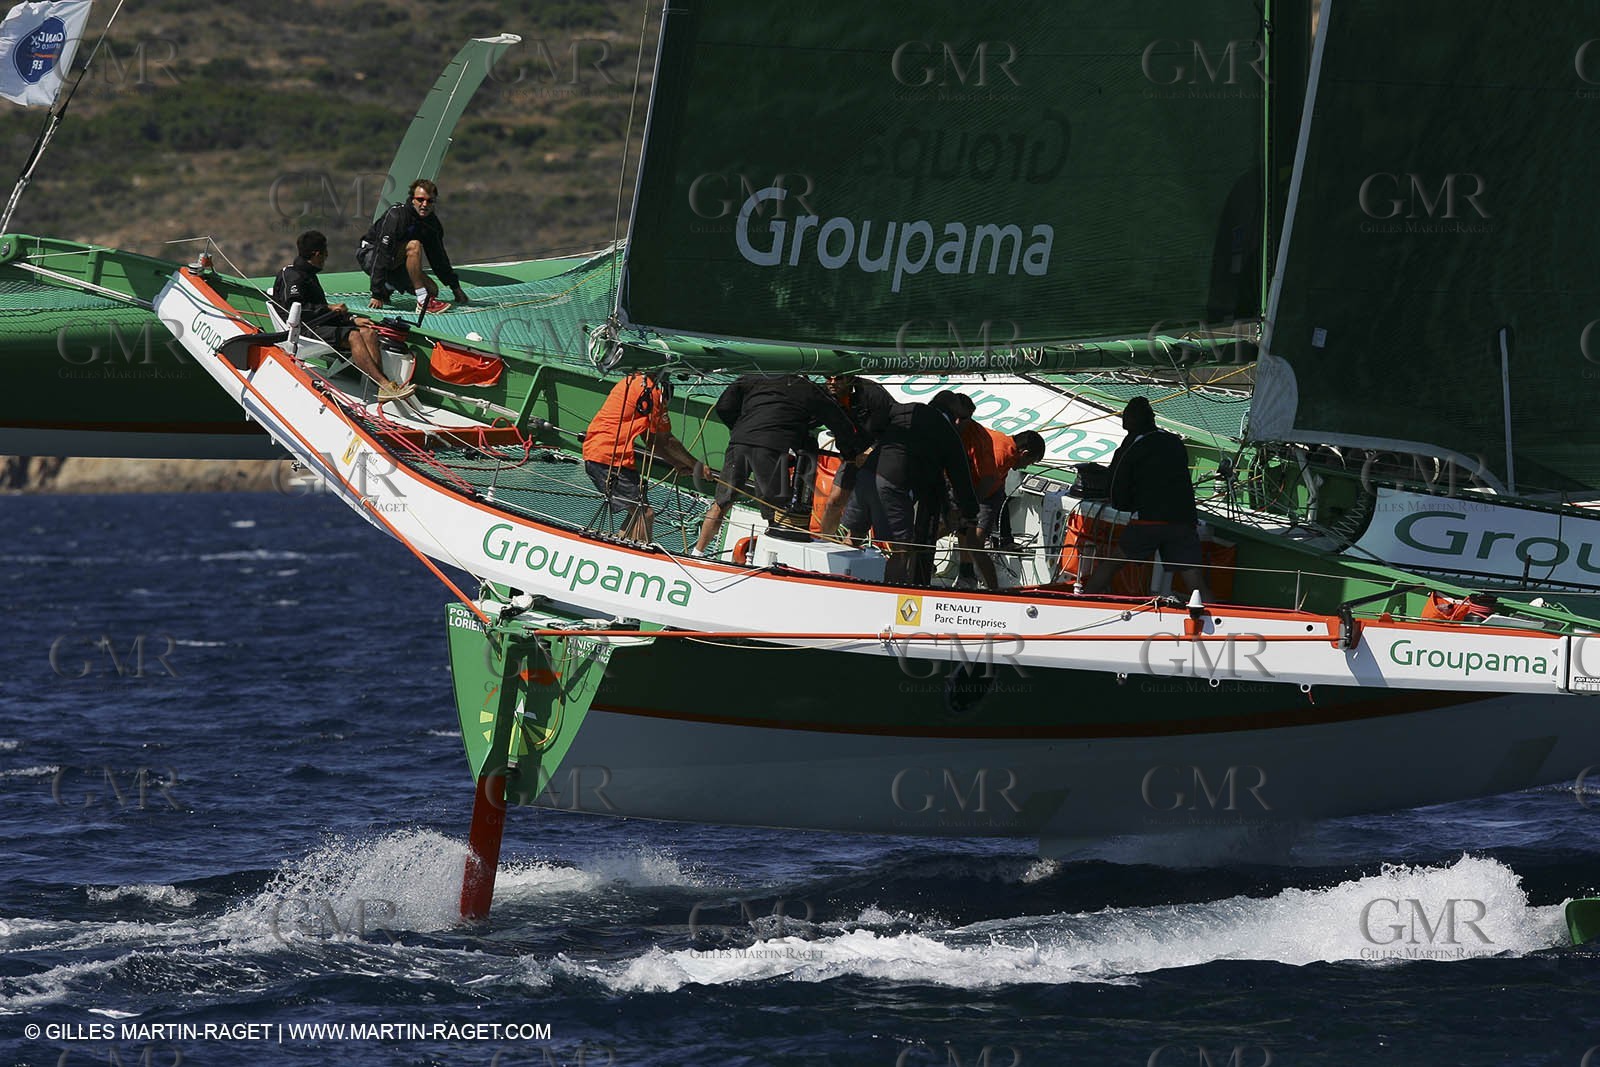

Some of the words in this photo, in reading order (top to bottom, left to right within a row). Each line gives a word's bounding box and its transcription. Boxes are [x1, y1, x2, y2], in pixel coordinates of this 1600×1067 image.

[735, 187, 1054, 292] Groupama
[482, 523, 692, 607] Groupama
[934, 613, 954, 624] Parc
[956, 616, 1007, 628] Entreprises
[935, 603, 982, 614] RENAULT
[1389, 639, 1547, 676] Groupama
